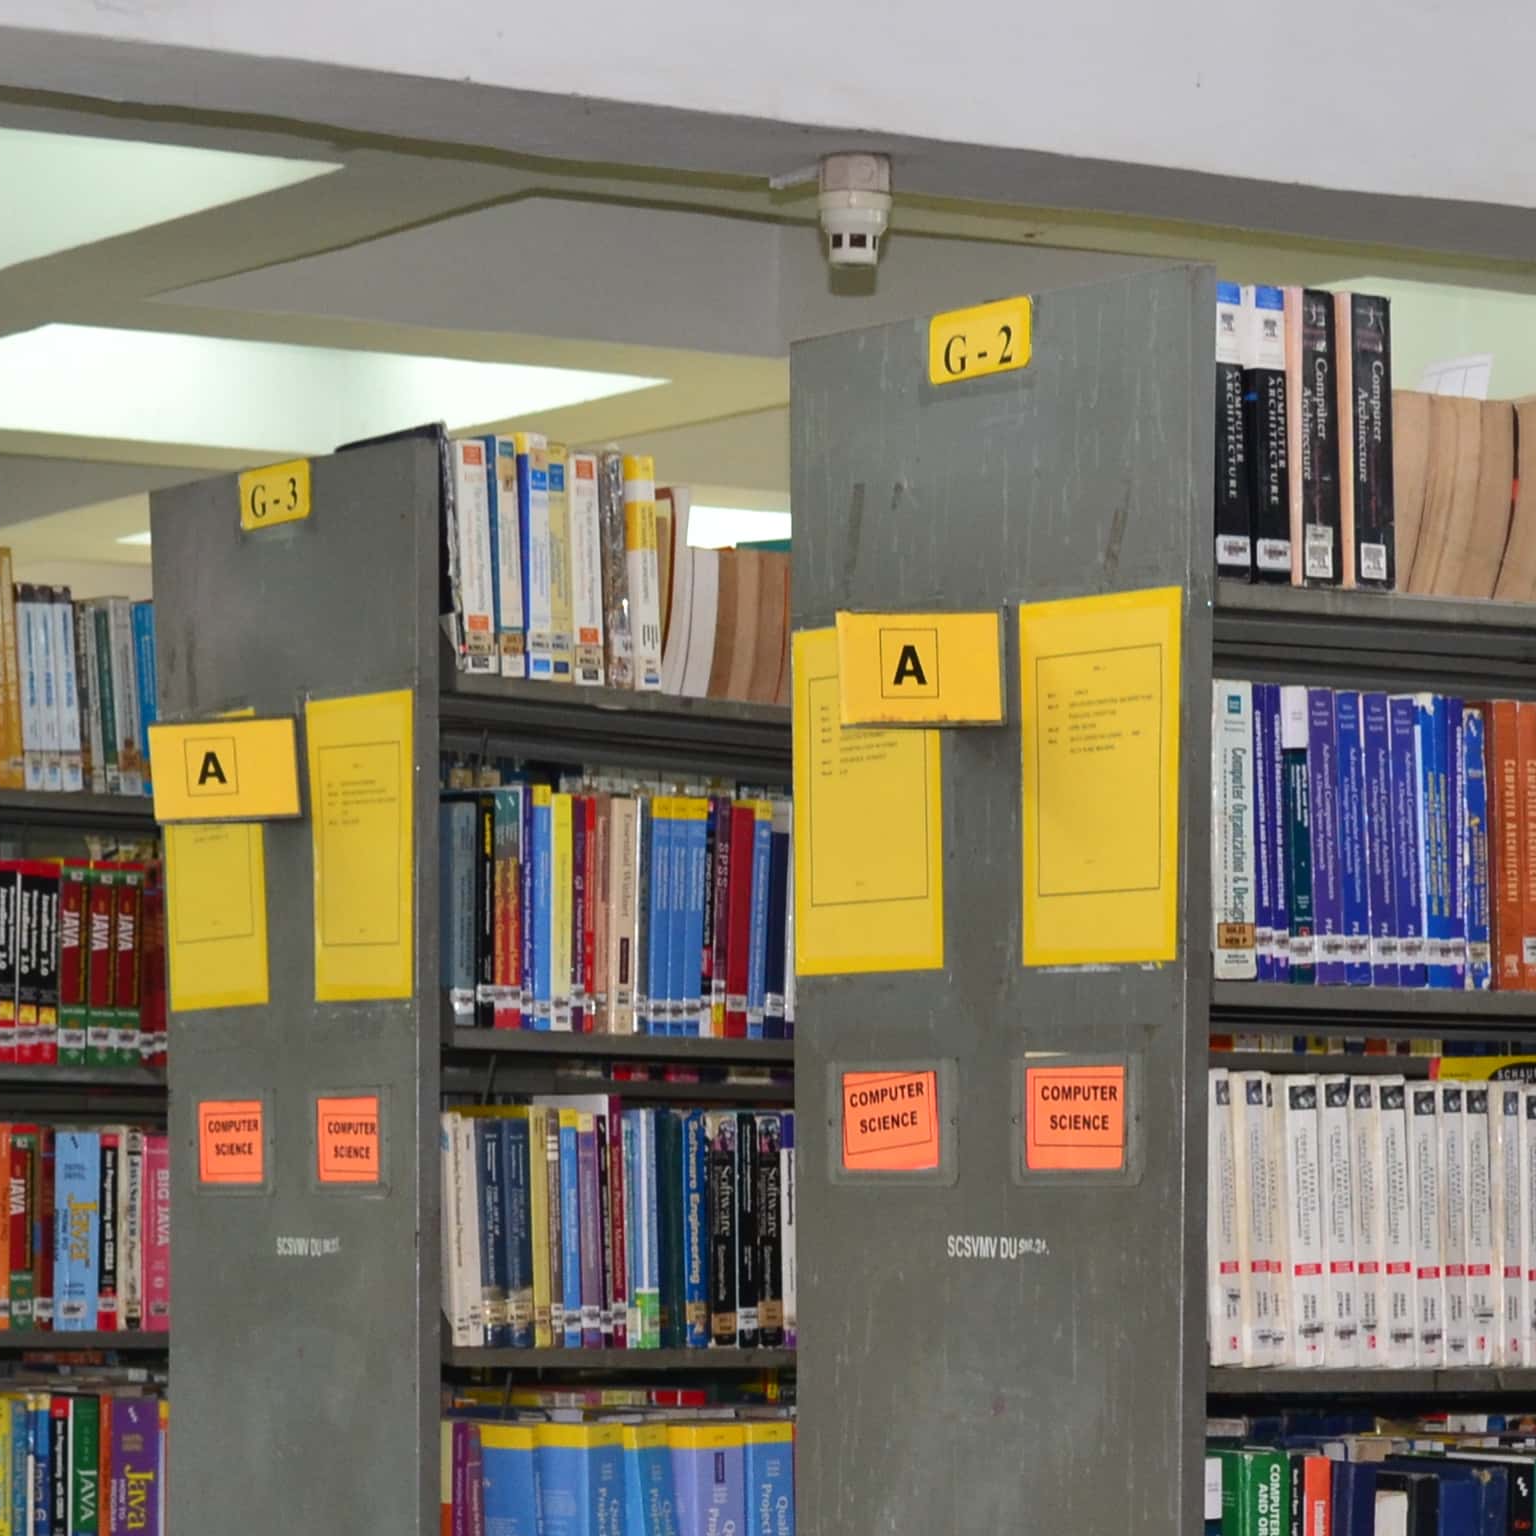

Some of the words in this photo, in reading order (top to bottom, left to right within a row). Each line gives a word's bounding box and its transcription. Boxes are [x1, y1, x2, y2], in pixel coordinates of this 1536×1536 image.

[1371, 360, 1384, 442] Computer
[1268, 376, 1279, 505] ARCHITECTURE
[1276, 377, 1286, 468] COMPUTER
[1358, 387, 1369, 482] Architecture
[893, 645, 927, 686] A
[197, 751, 228, 785] A
[1230, 747, 1246, 803] Computer
[1504, 759, 1516, 819] COMPUTER
[1231, 803, 1248, 875] Organization
[715, 842, 728, 889] SPSS
[1505, 823, 1518, 903] ARCHITECTURE
[118, 913, 133, 951] JAVA
[849, 1082, 924, 1108] COMPUTER
[1041, 1086, 1118, 1101] COMPUTER
[208, 1120, 259, 1133] COMPUTER
[327, 1122, 376, 1136] COMPUTER
[859, 1111, 918, 1134] SCIENCE
[1050, 1115, 1109, 1131] SCIENCE
[216, 1143, 253, 1155] SCIENCE
[334, 1147, 370, 1159] SCIENCE
[156, 1169, 169, 1200] BIG
[720, 1166, 733, 1236] Software
[157, 1206, 169, 1246] JAVA
[77, 1469, 97, 1522] JAVA
[124, 1464, 154, 1529] Java
[1258, 1483, 1268, 1514] AND
[1269, 1464, 1280, 1536] COMPUTER
